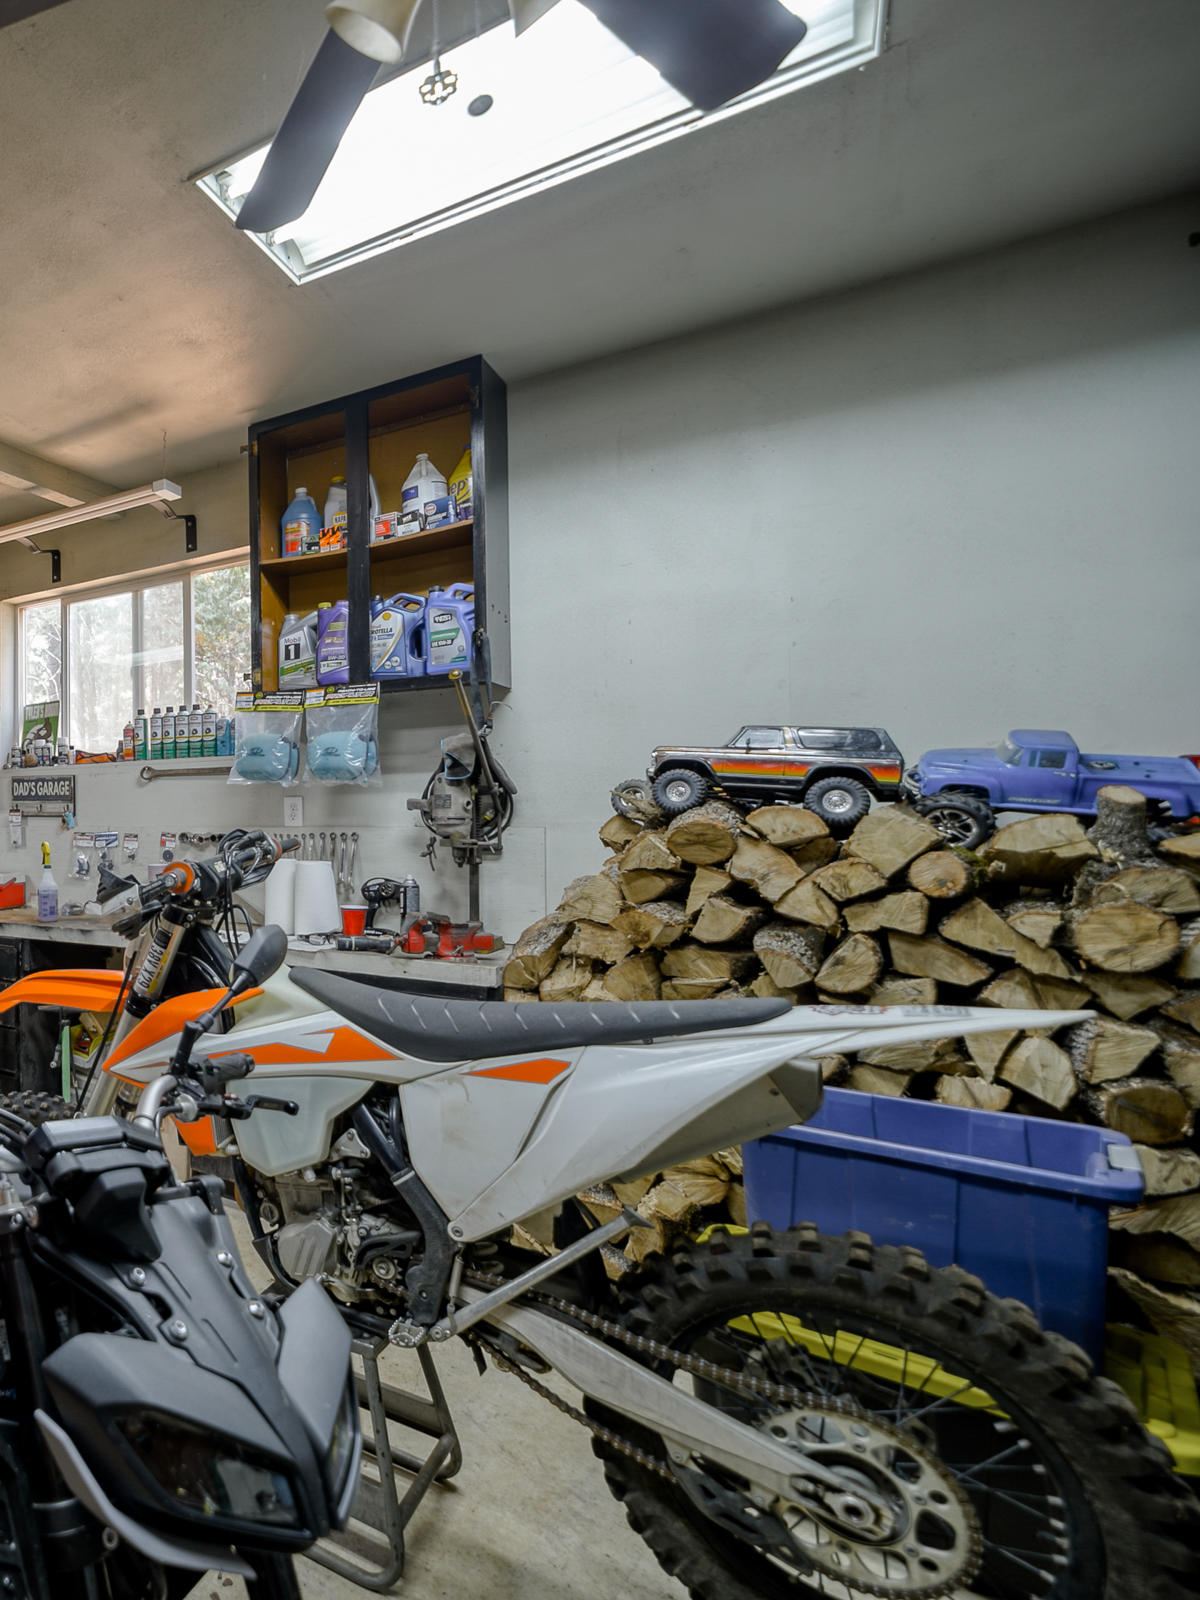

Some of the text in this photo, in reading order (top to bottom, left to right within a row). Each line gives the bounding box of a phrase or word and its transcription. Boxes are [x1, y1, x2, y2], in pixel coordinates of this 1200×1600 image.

[448, 480, 465, 496] ep
[288, 645, 296, 660] 1
[13, 781, 70, 796] DAD'S GARAGE
